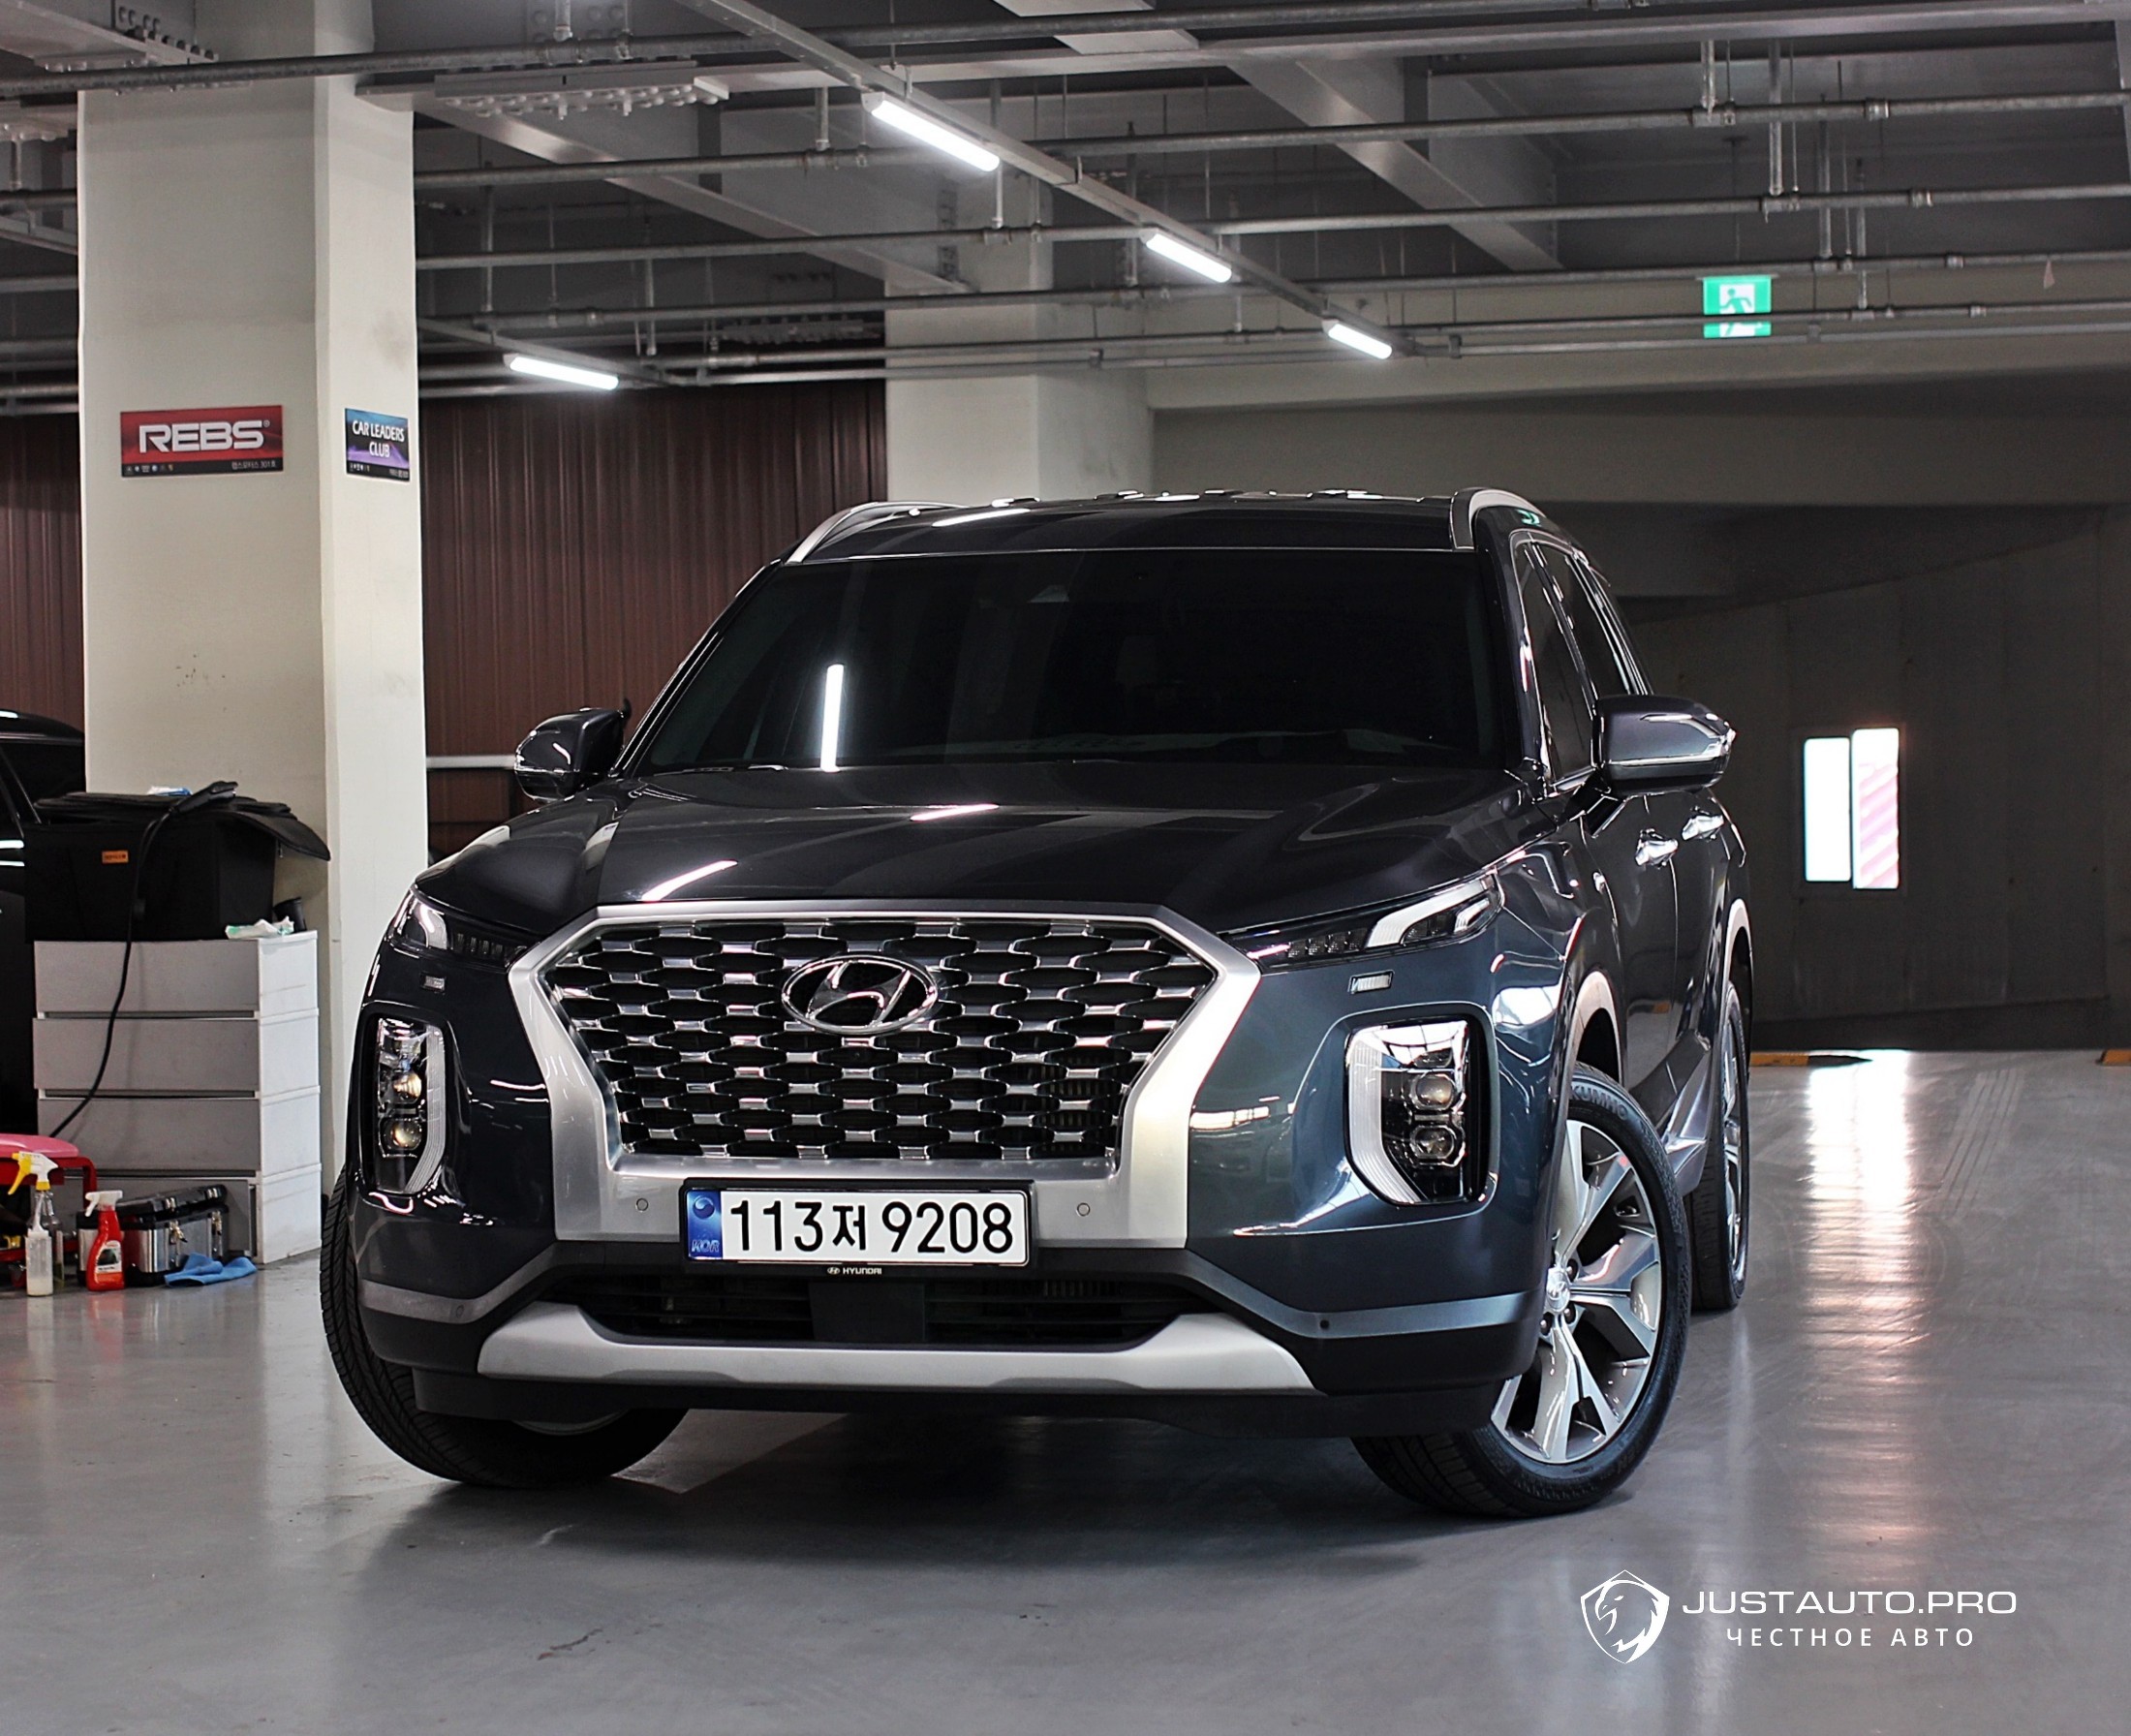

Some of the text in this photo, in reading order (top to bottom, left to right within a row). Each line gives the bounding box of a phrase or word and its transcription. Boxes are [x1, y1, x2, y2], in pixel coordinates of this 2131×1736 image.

[139, 419, 264, 453] REBS
[353, 420, 405, 443] CAR LEADERS
[369, 441, 390, 458] CLUB
[1570, 1084, 1628, 1121] KUMHO
[881, 1201, 1013, 1254] 9208
[691, 1239, 720, 1253] KOR
[842, 1266, 882, 1276] HYUNDAI
